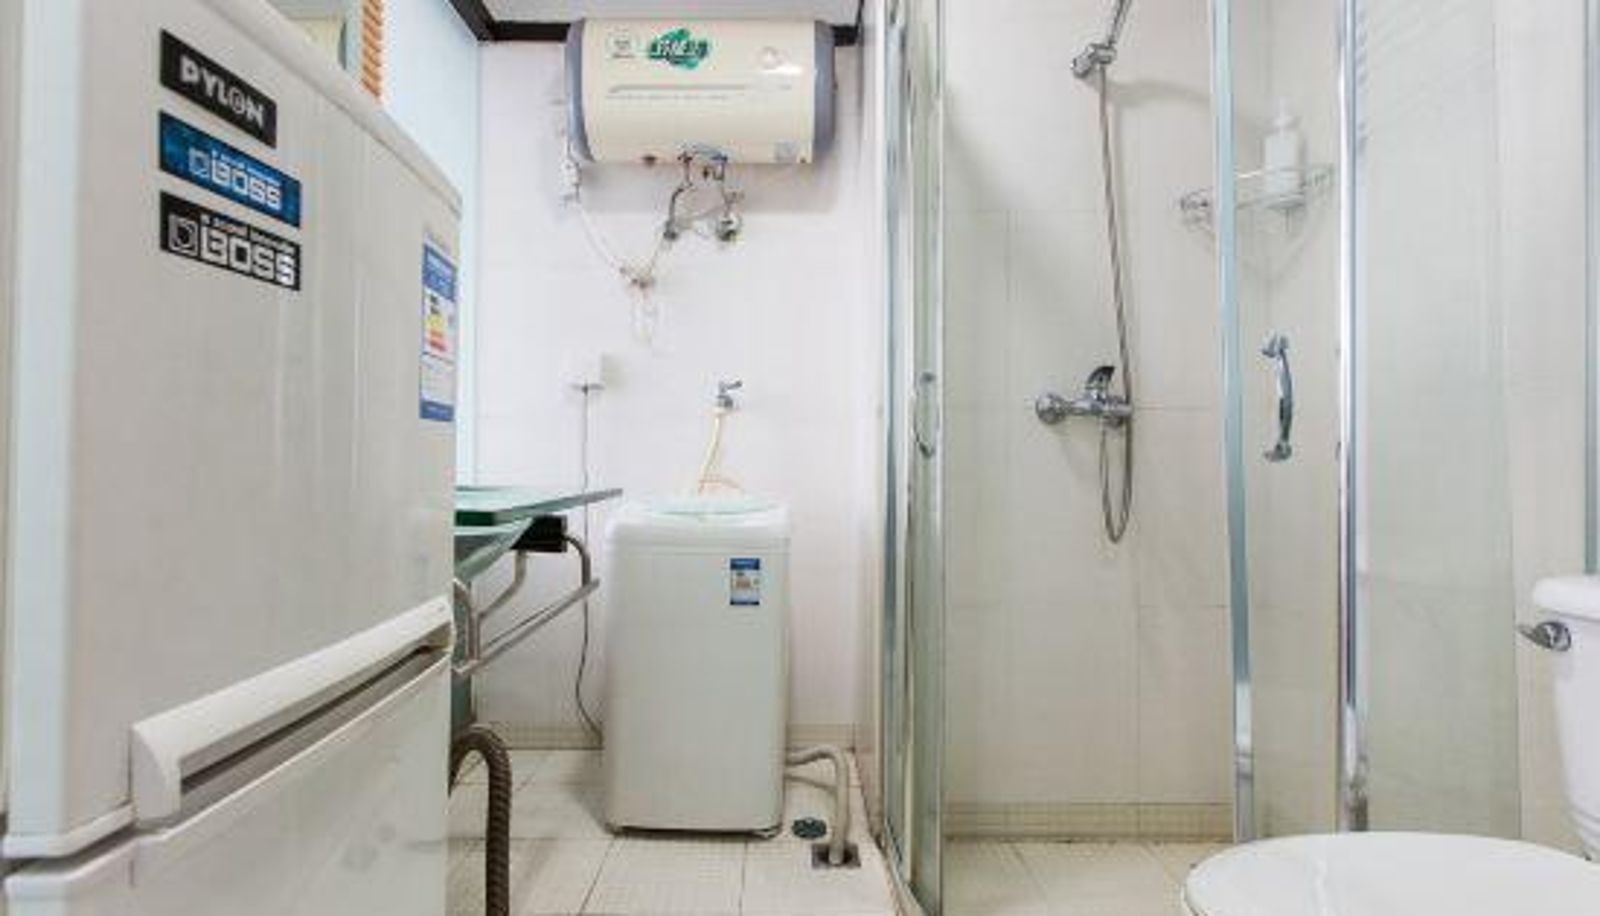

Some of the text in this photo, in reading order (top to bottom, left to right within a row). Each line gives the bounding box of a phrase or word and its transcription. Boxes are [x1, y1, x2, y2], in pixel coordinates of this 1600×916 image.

[180, 54, 264, 127] PYLON
[212, 157, 281, 211] BOSS
[201, 225, 296, 286] BOSS
